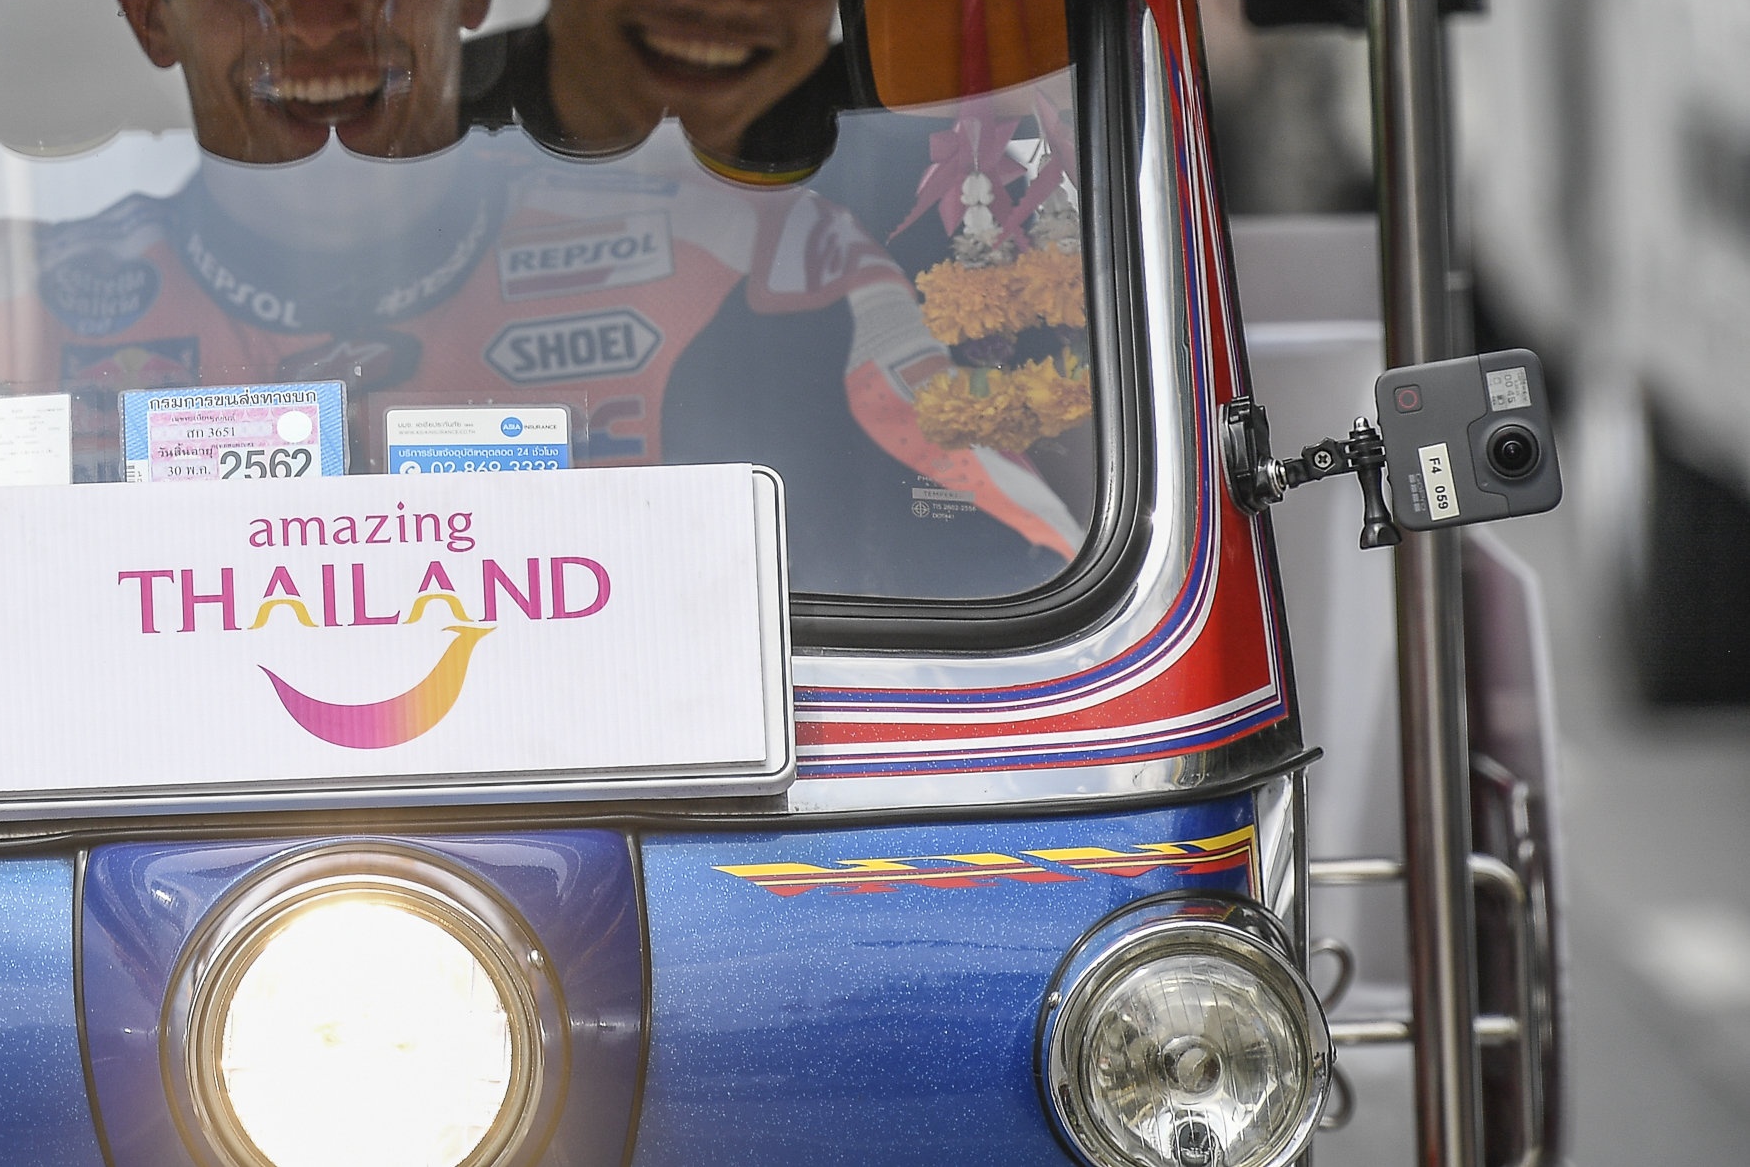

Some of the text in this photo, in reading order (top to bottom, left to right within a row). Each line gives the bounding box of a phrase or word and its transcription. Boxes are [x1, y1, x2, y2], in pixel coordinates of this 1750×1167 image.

[507, 232, 659, 275] REPSOL
[512, 324, 636, 376] SHOEI
[149, 388, 317, 411] กรมการขนส่งทางบก
[208, 427, 236, 438] 3651
[158, 443, 213, 459] วันสิ้นอายุ
[220, 448, 312, 480] 2562
[517, 447, 529, 457] 24
[532, 445, 559, 457] ชั่วโมง
[167, 466, 182, 477] 30
[1428, 457, 1449, 511] F4 059
[248, 501, 477, 552] amazing
[117, 555, 611, 634] THAILAND
